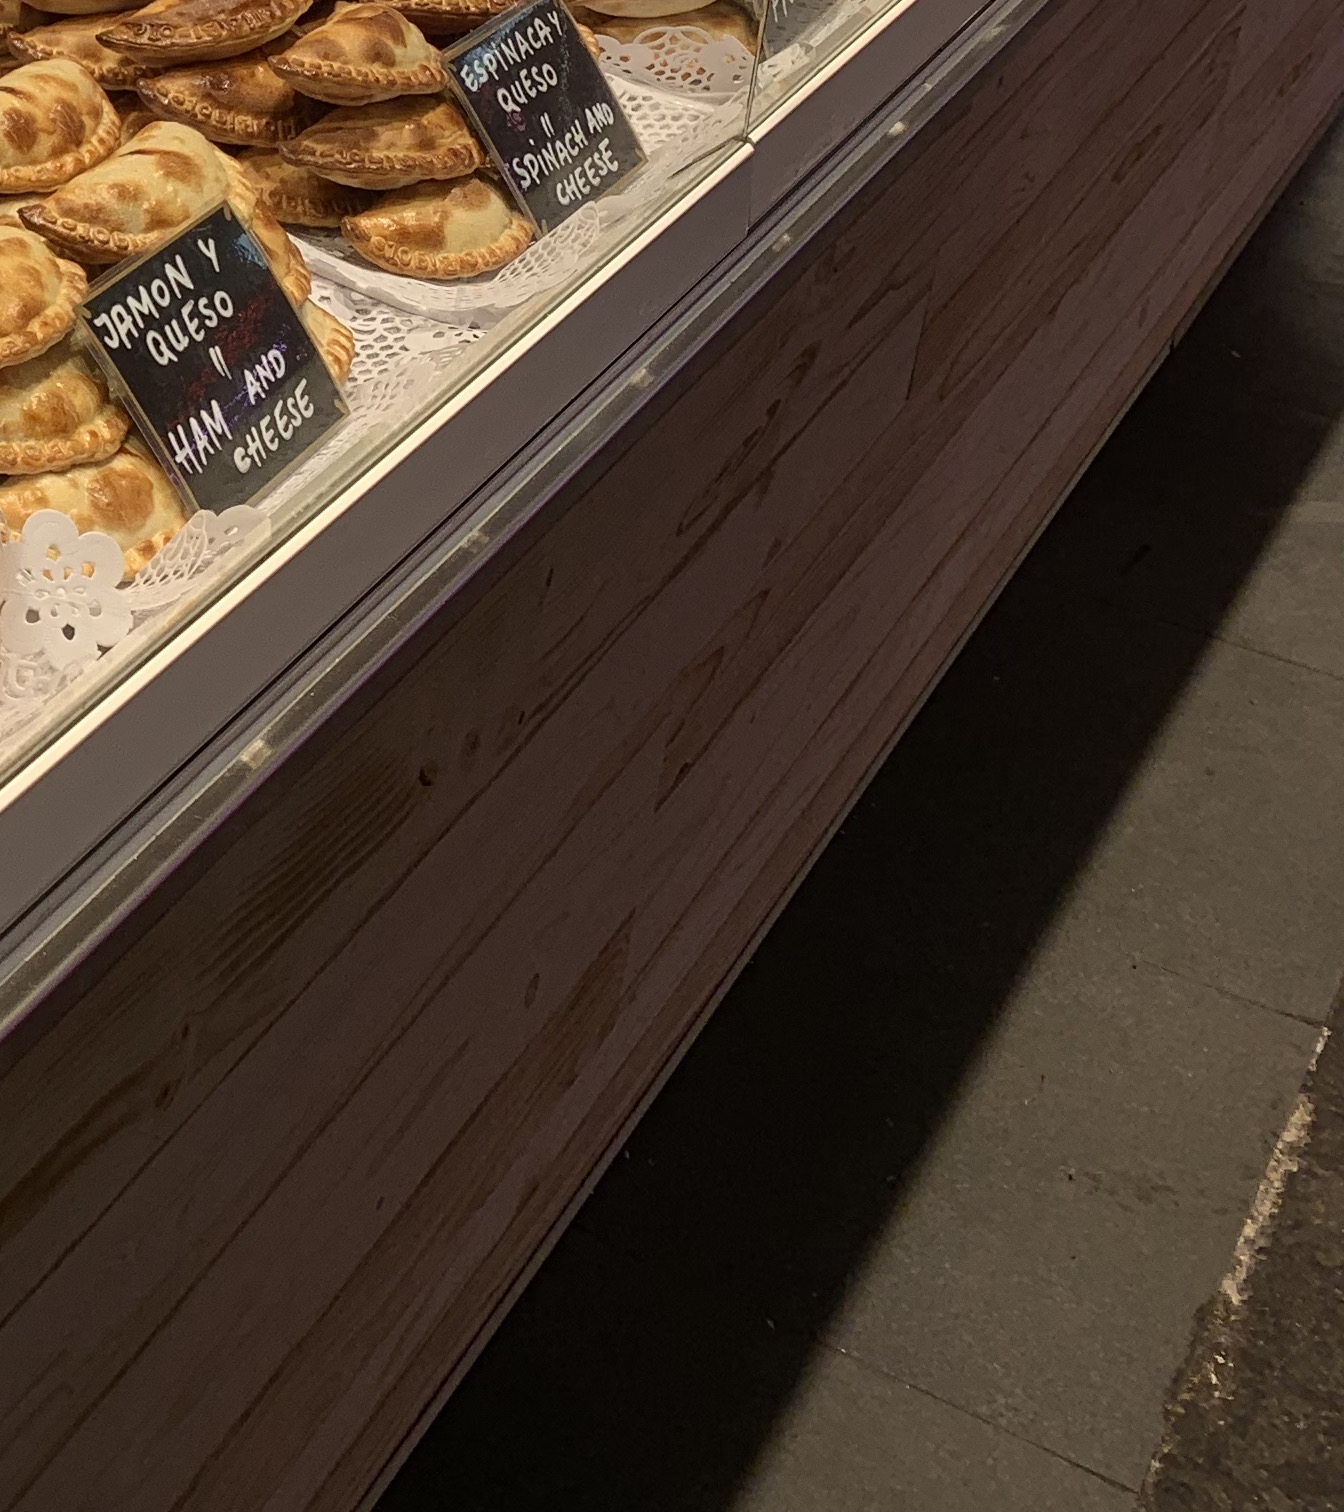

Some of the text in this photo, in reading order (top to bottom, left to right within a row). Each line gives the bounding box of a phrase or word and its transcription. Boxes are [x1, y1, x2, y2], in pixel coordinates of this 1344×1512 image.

[547, 10, 563, 37] Y
[496, 63, 558, 114] QUESO
[584, 102, 614, 134] AND
[555, 138, 618, 206] CHEESE
[93, 238, 220, 350] JAMON Y
[145, 290, 234, 367] QUESO
[167, 348, 286, 474] HAM AND
[233, 378, 314, 474] CHEESE
